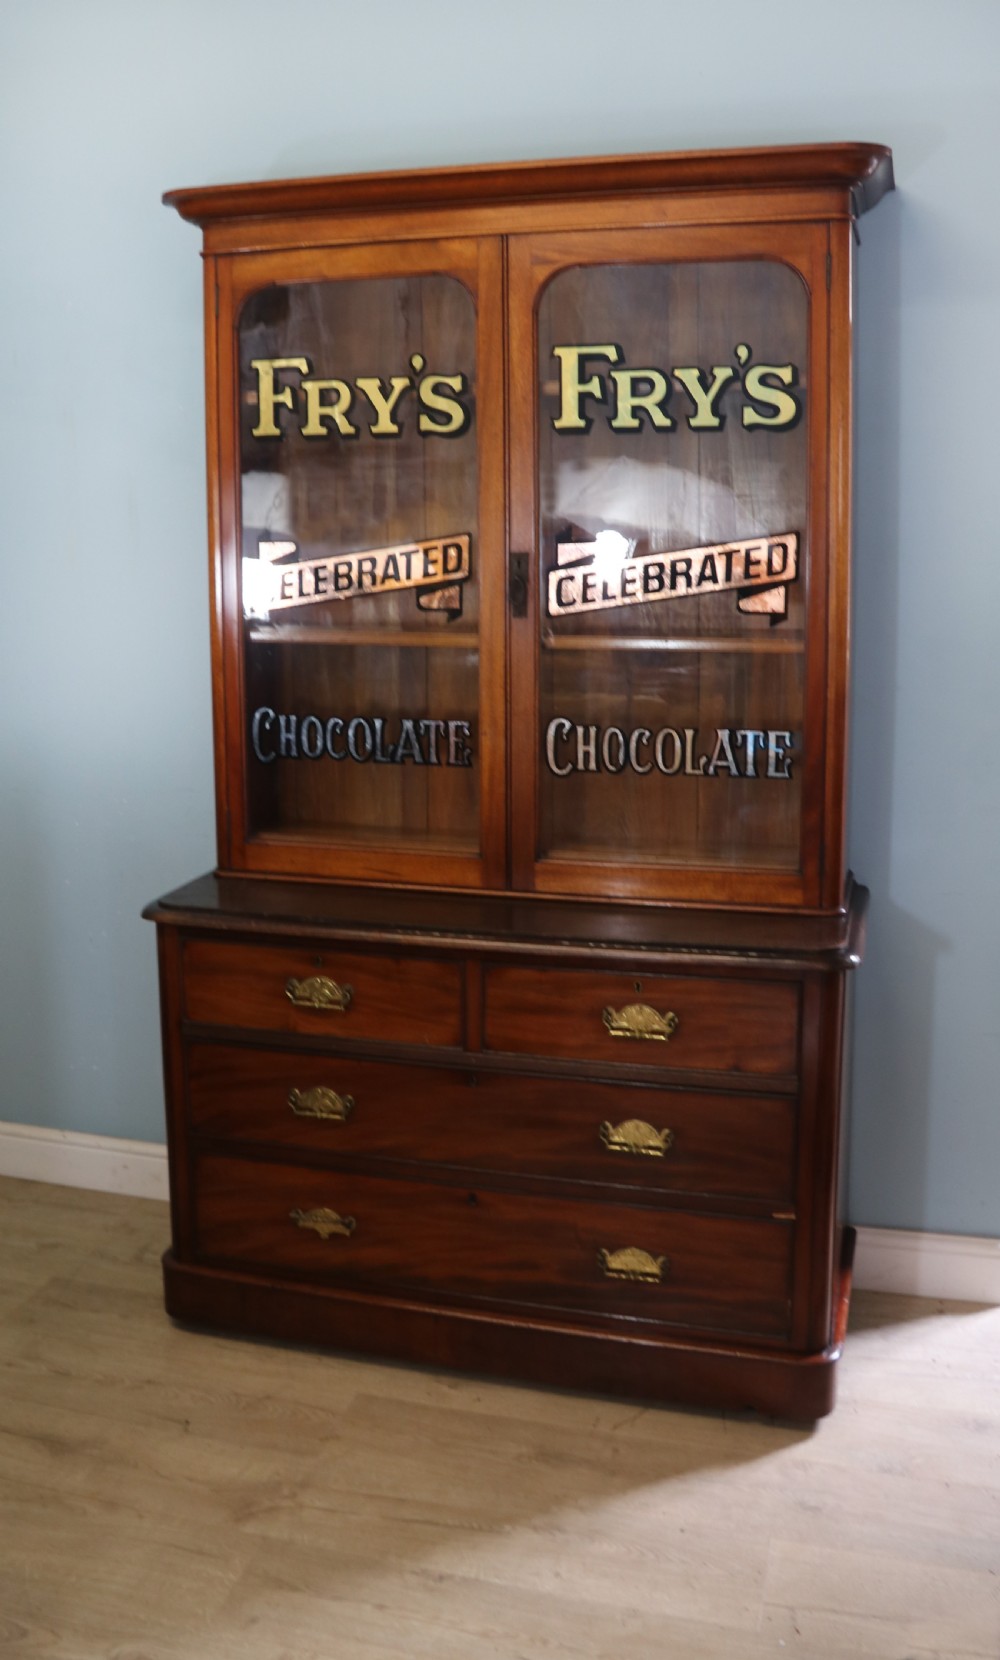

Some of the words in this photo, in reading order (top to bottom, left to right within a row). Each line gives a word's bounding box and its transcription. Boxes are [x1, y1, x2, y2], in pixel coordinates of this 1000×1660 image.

[251, 353, 471, 439] FRY'S
[553, 343, 802, 432] FRY'S
[268, 542, 463, 603] ELEBRATED
[251, 706, 473, 768] CHOCOLATE
[545, 717, 793, 779] CHOCOLATE
